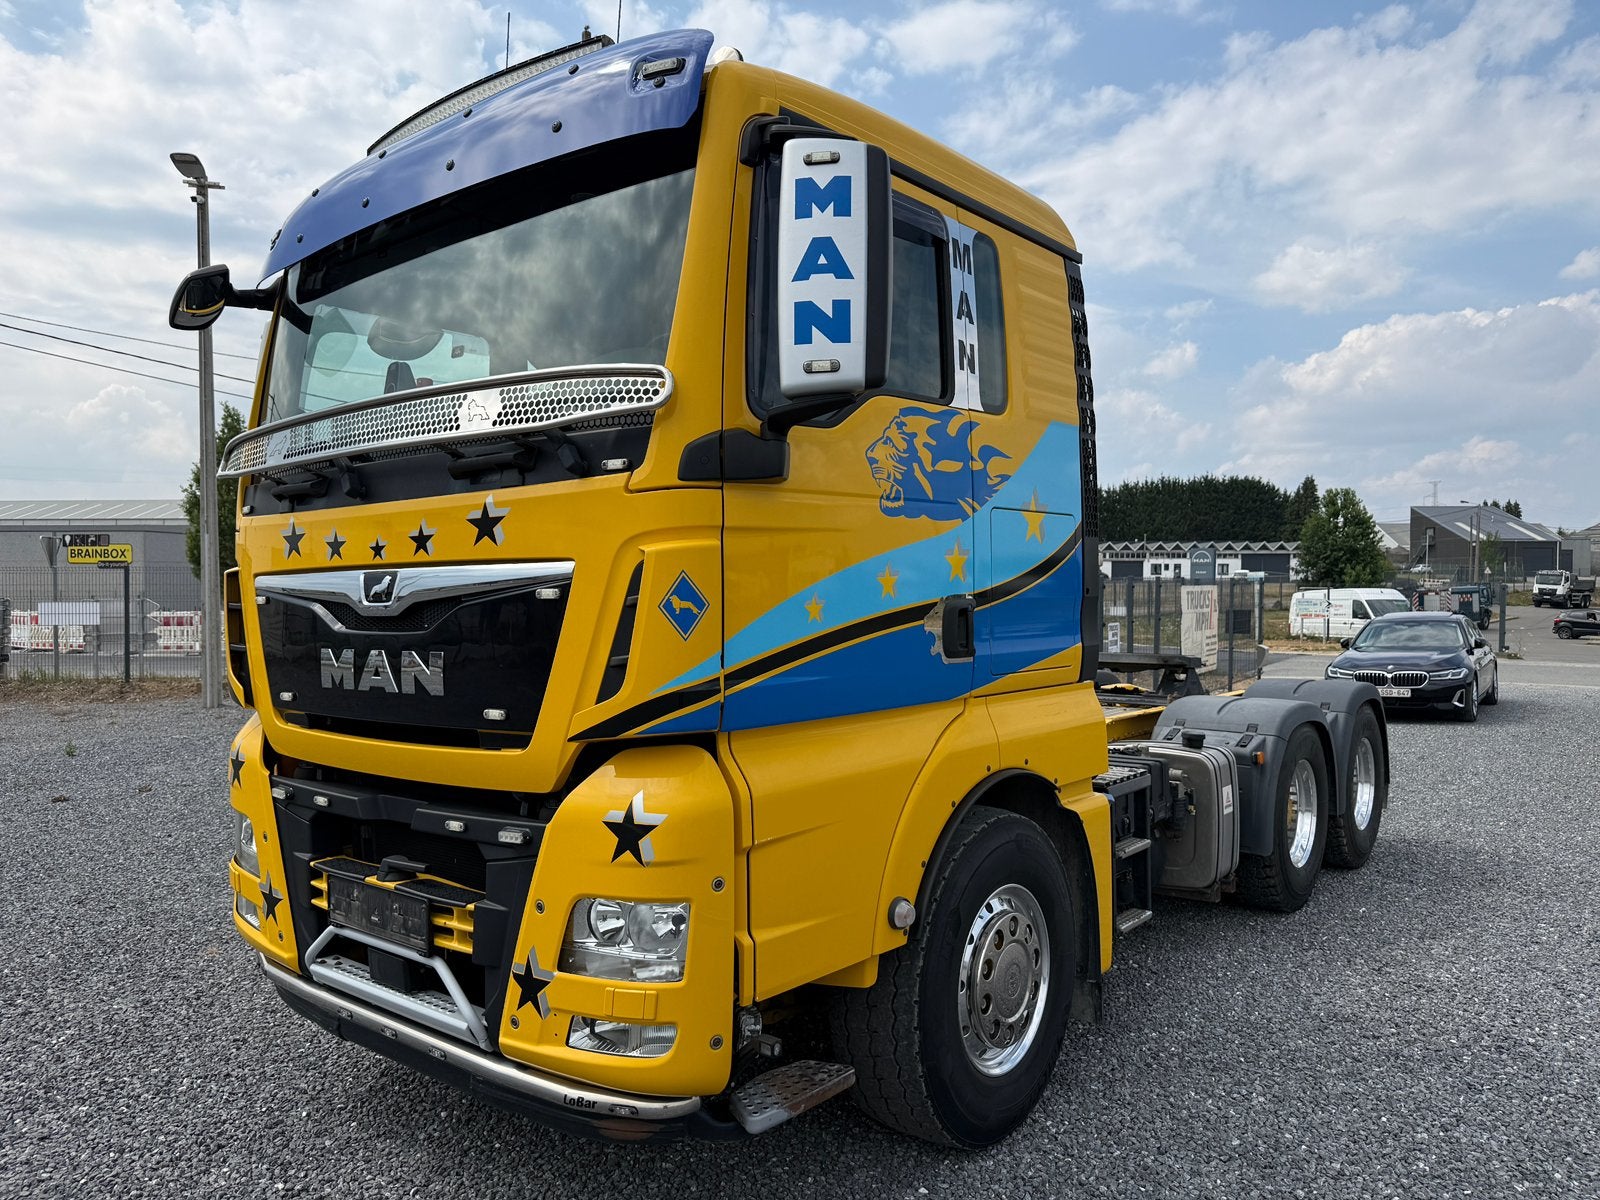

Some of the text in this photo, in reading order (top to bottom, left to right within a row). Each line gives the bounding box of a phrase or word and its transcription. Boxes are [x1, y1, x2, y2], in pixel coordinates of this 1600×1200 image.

[791, 175, 855, 346] MAN
[951, 236, 976, 375] MAN
[70, 548, 127, 559] BRAINBOX
[1186, 590, 1211, 610] TRUCKS
[320, 648, 445, 697] MAN
[563, 1094, 598, 1109] LoBar
